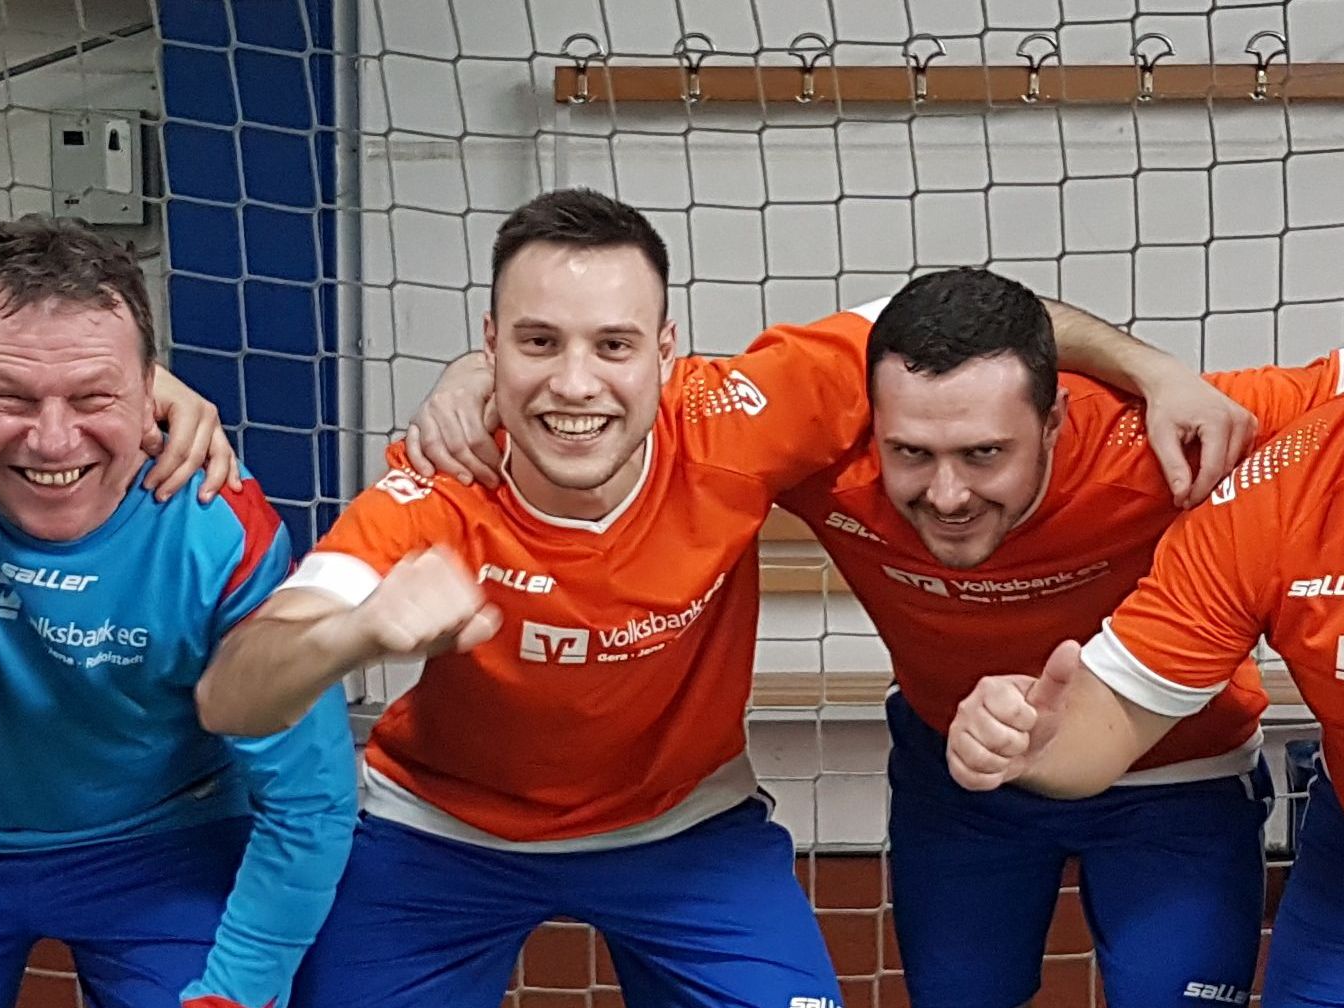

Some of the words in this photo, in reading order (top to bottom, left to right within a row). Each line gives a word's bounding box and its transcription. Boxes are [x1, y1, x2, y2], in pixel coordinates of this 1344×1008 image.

[1, 562, 100, 592] saller
[950, 571, 1075, 593] Volksbank
[598, 600, 704, 648] Volksbank
